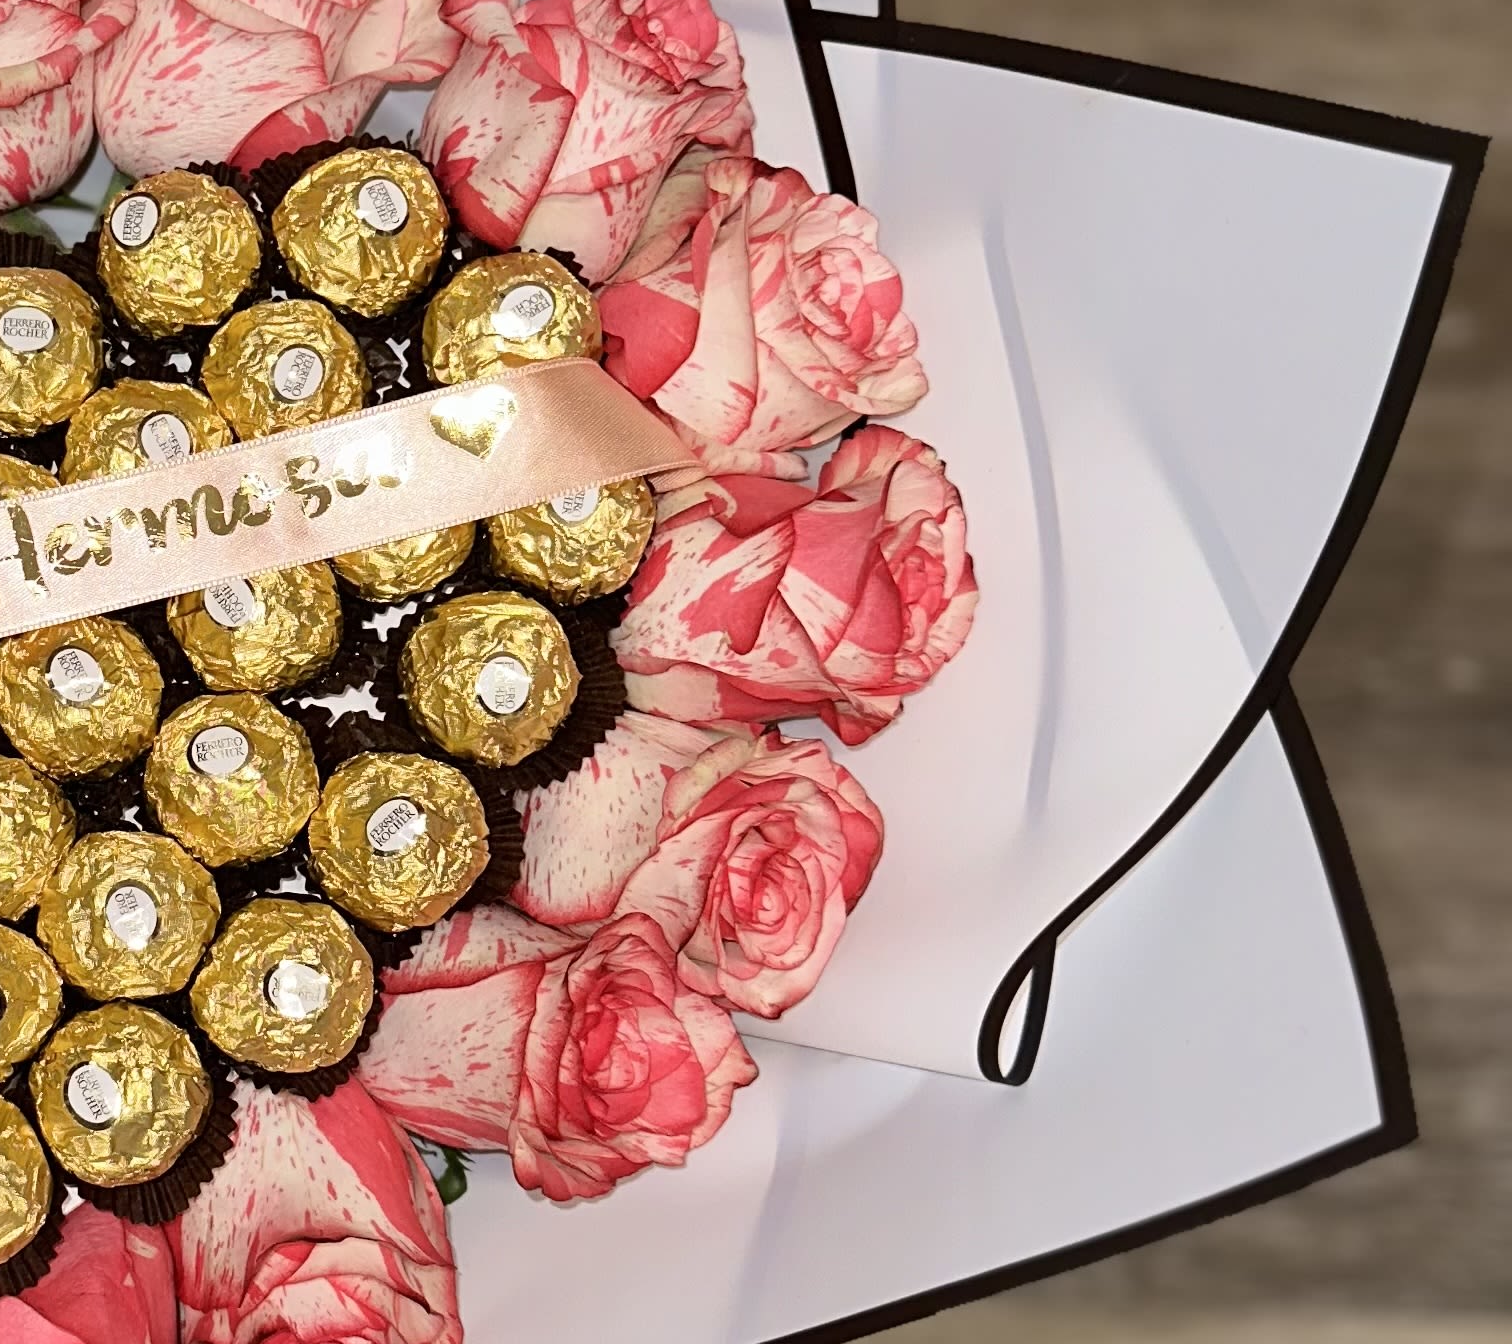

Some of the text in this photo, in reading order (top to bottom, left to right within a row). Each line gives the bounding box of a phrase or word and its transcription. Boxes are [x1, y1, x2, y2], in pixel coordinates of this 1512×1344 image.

[122, 200, 138, 241] FERRERO
[130, 200, 148, 241] ROCHER
[375, 181, 400, 225] FERRERO
[2, 317, 50, 330] FERRERO
[2, 328, 49, 340] ROCHER
[281, 350, 307, 393] ROCER
[291, 353, 316, 397] FERRERO
[220, 584, 246, 617] ROCHE
[369, 802, 409, 841] FERRERO
[375, 809, 417, 848] ROCHER
[75, 1072, 103, 1120] ROCHER
